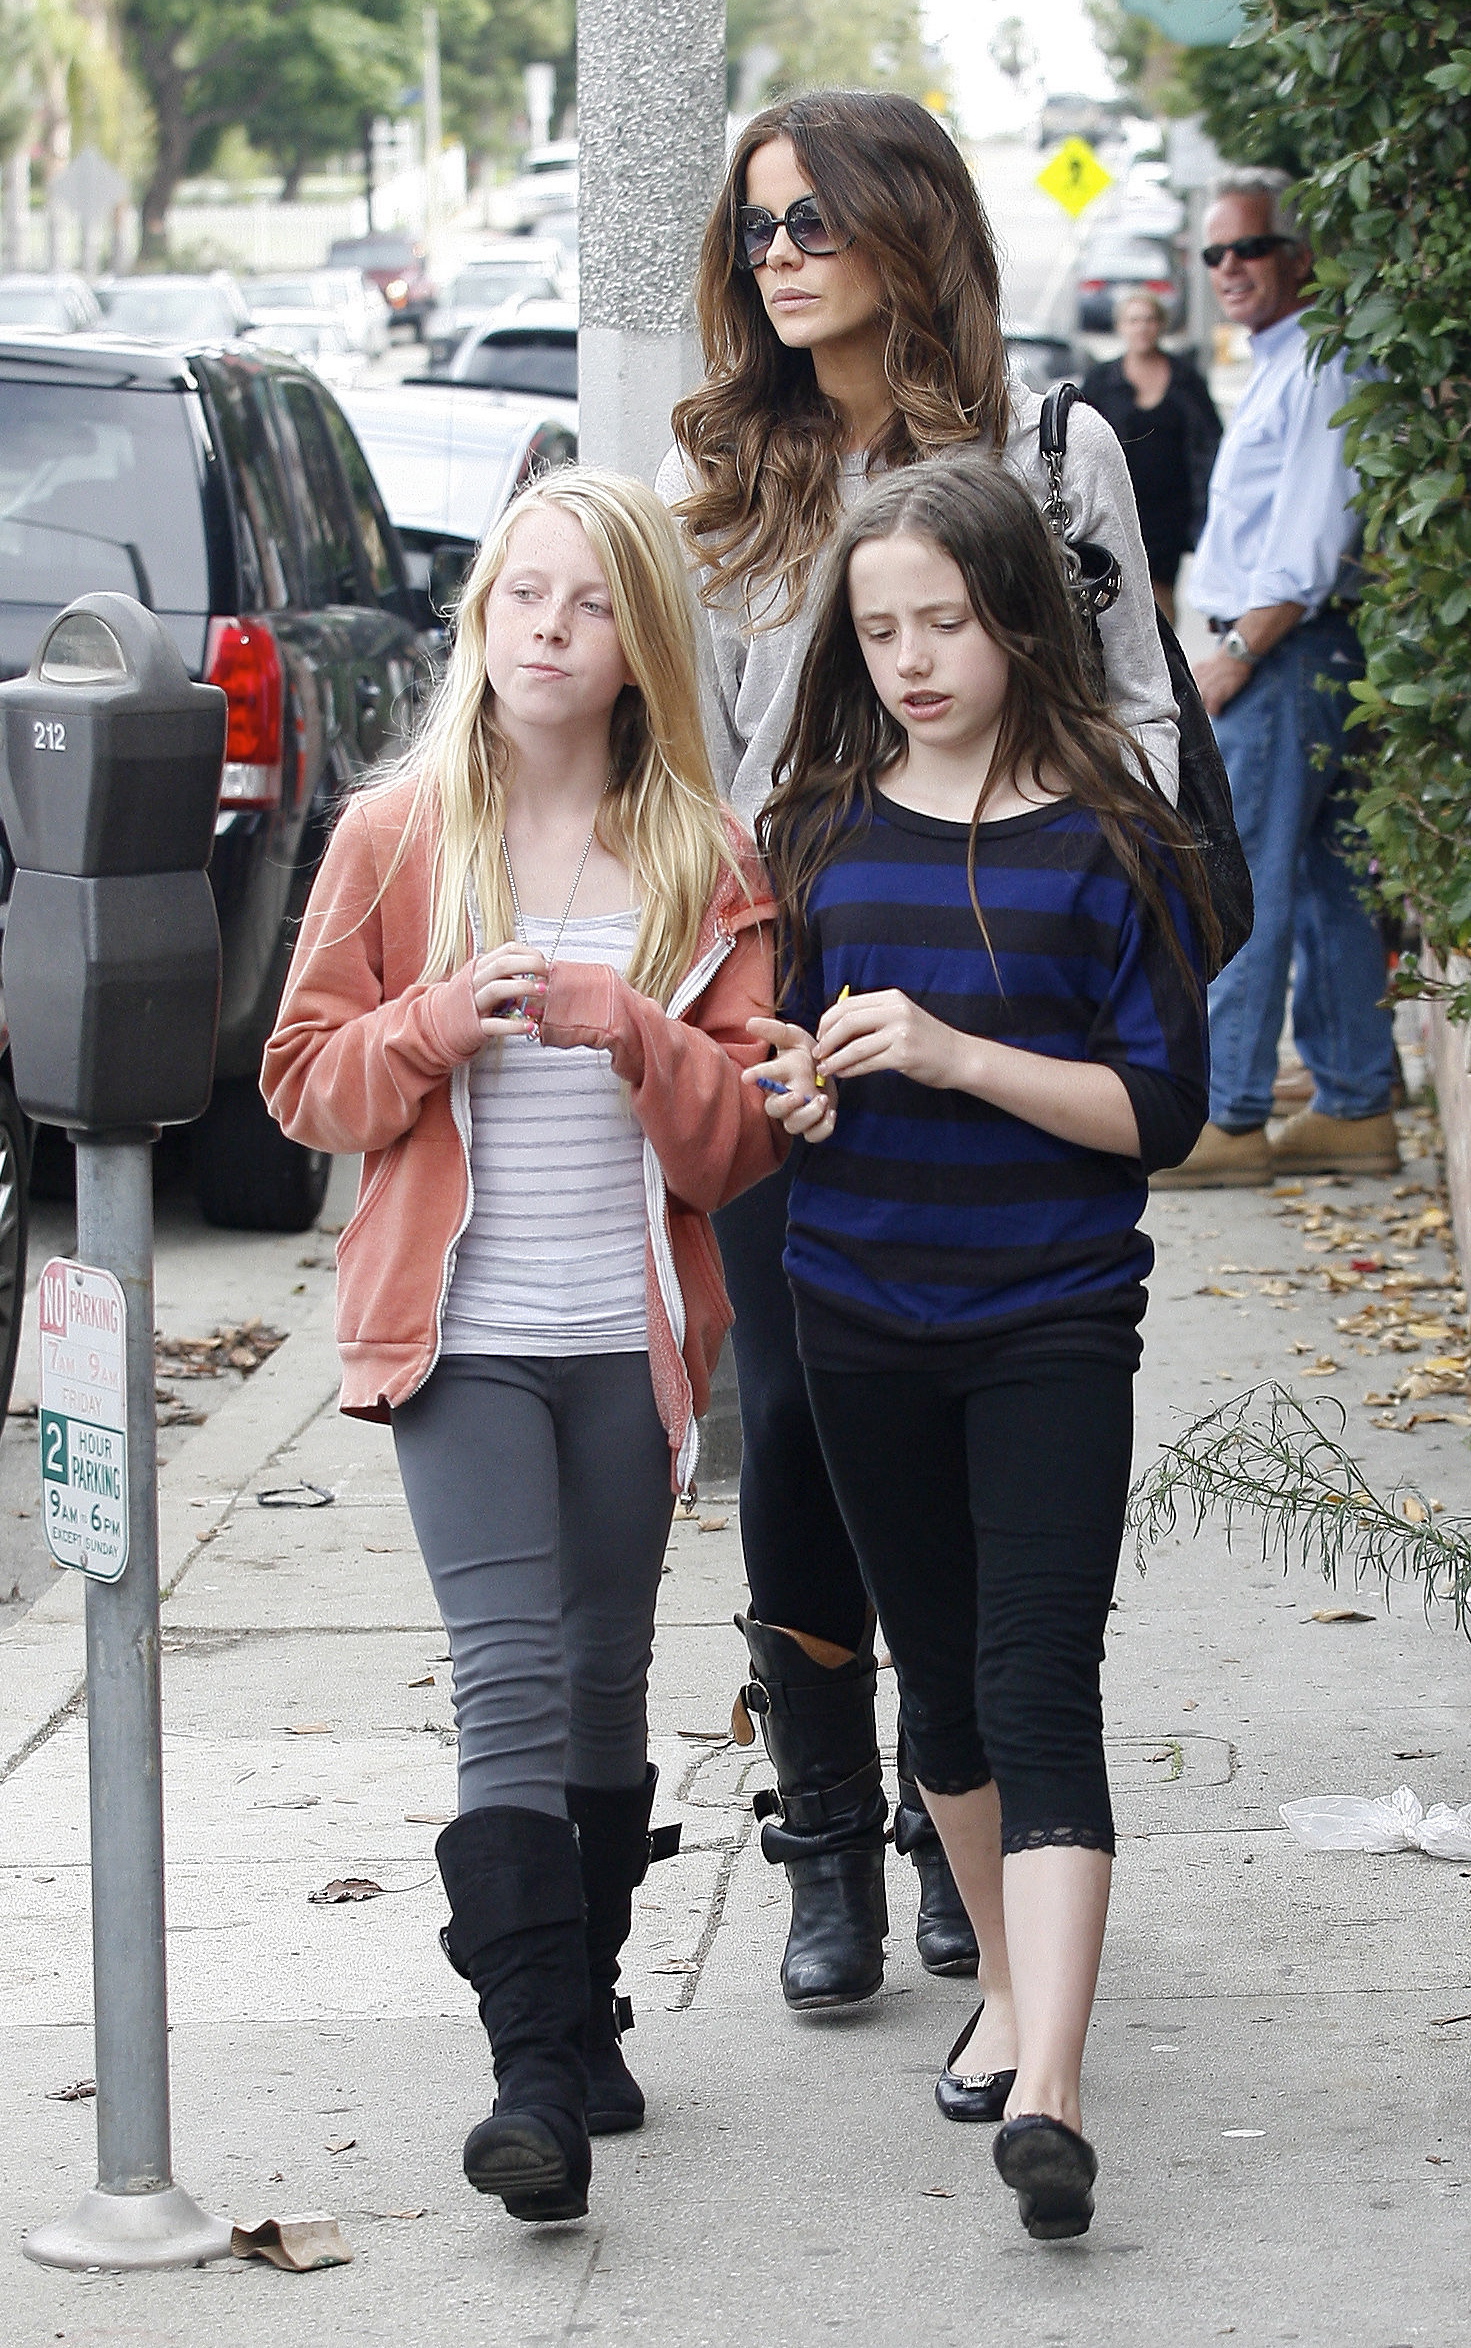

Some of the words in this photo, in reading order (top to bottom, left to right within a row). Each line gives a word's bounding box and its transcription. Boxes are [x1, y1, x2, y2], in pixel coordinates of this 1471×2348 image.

[33, 721, 66, 751] 212
[44, 1276, 65, 1328] NO
[70, 1289, 119, 1333] PARKING
[63, 1386, 103, 1416] FRIDAY
[46, 1421, 64, 1473] 2
[79, 1430, 113, 1459] HOUR
[72, 1455, 121, 1500] PARKING
[53, 1525, 82, 1546] EXCEPT
[85, 1537, 119, 1557] SUNDAY
